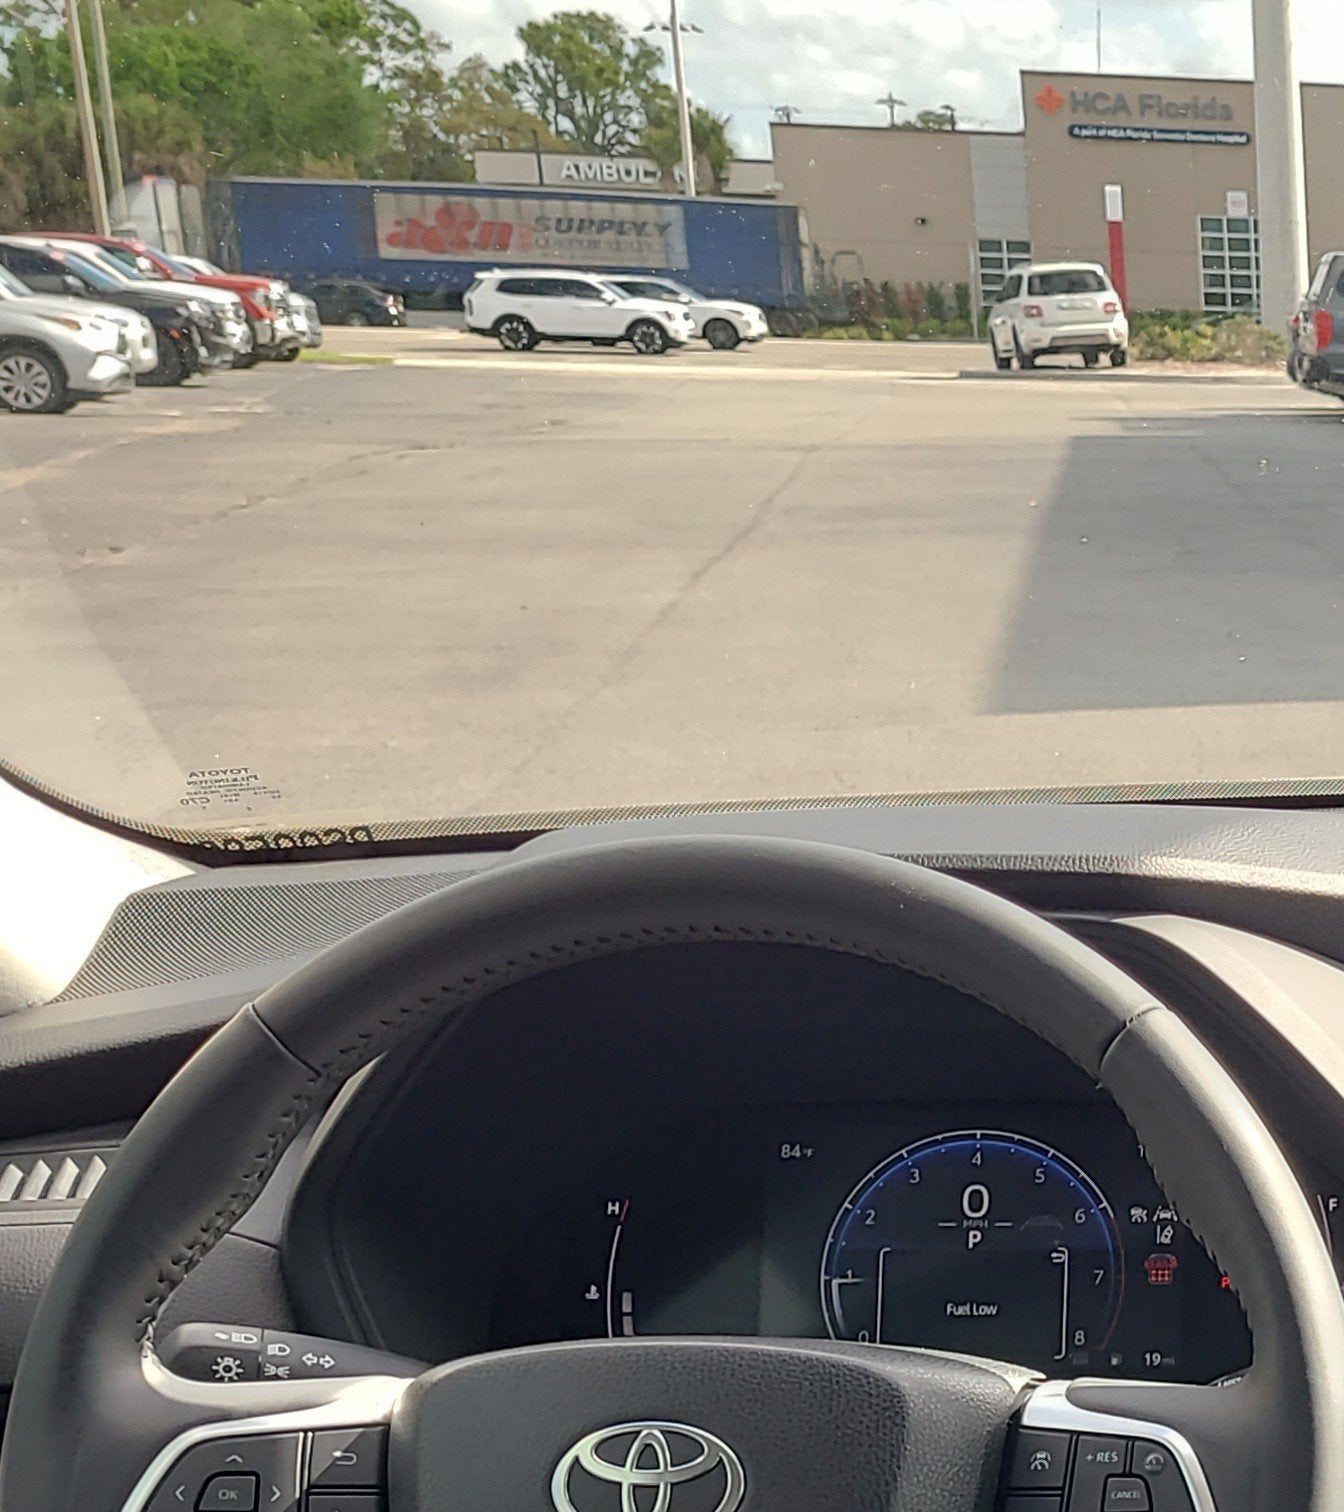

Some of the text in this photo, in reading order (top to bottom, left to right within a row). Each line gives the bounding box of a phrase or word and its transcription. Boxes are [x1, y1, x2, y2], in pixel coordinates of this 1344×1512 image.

[1068, 91, 1234, 121] HCA Florida
[971, 1151, 982, 1167] 4
[909, 1168, 921, 1184] 3
[1034, 1168, 1045, 1184] 5
[607, 1201, 620, 1216] H
[962, 1184, 990, 1218] 0
[1328, 1198, 1338, 1212] F
[865, 1209, 876, 1225] 2
[1075, 1207, 1086, 1224] 6
[968, 1230, 982, 1250] P
[1093, 1269, 1105, 1286] 7
[946, 1303, 998, 1316] Fuel Low
[1074, 1329, 1085, 1346] 8
[217, 1488, 239, 1500] OK
[1110, 1490, 1142, 1500] CANCEL
